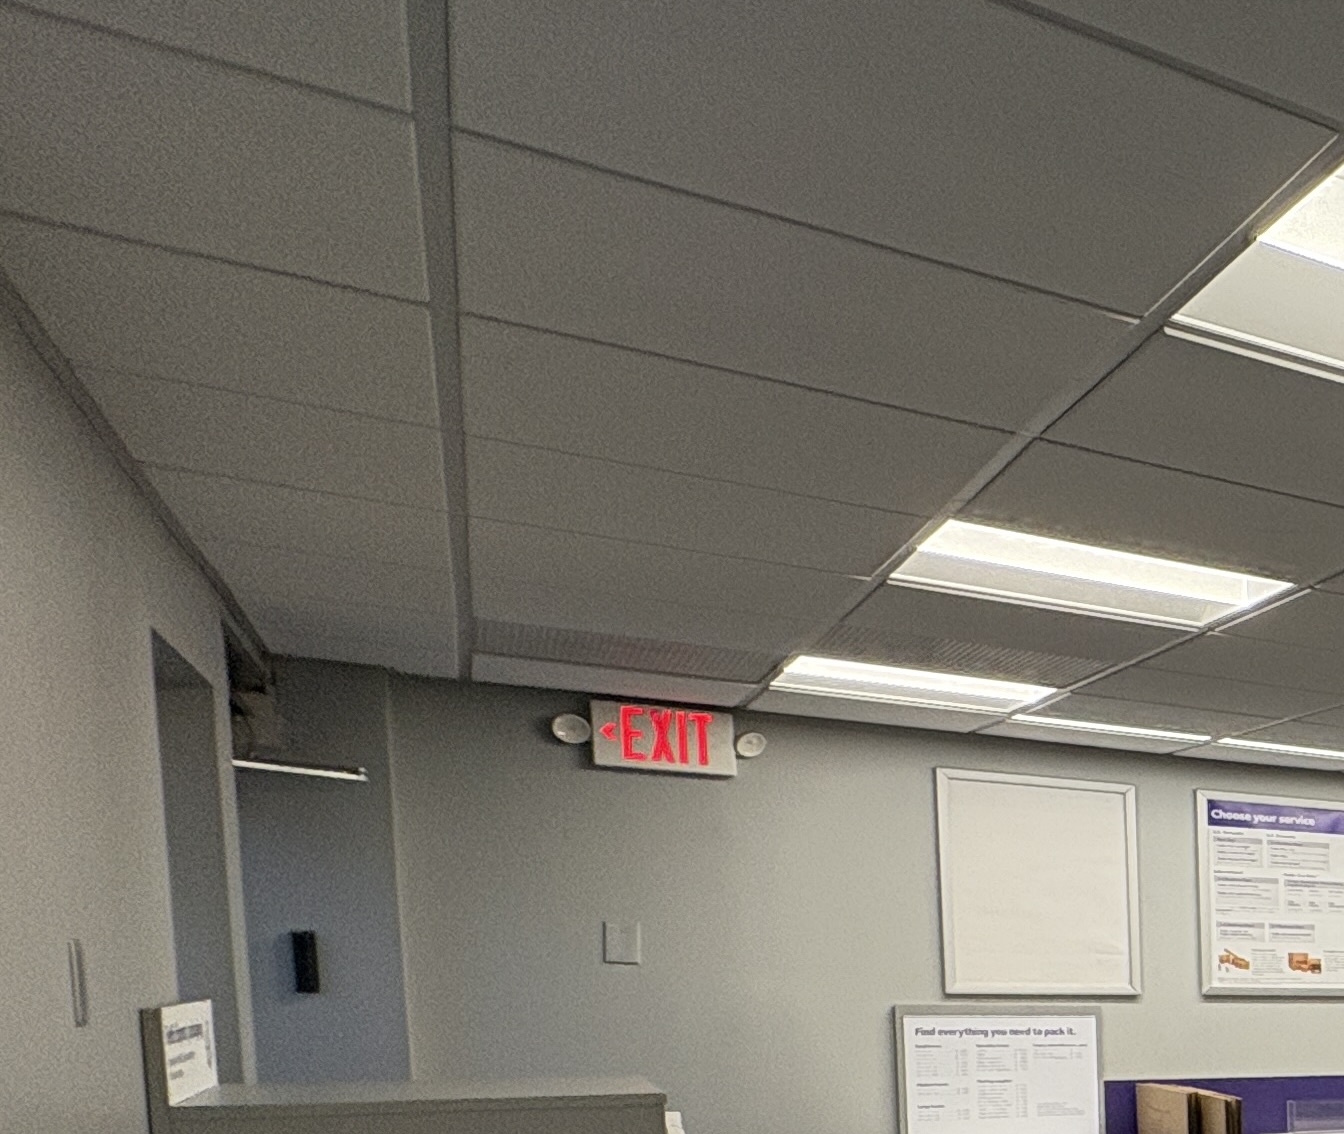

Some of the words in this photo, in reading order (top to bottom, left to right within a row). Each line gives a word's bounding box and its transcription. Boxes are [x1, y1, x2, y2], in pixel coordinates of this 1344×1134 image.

[619, 704, 713, 766] EXIT
[1211, 808, 1252, 822] Choose
[1253, 815, 1277, 825] your
[1279, 815, 1316, 827] service
[915, 1027, 935, 1036] Find
[938, 1027, 988, 1038] everything
[991, 1029, 1007, 1037] you
[1009, 1027, 1031, 1036] need
[1032, 1027, 1043, 1036] to
[1044, 1027, 1065, 1037] pack
[1066, 1027, 1077, 1036] it.
